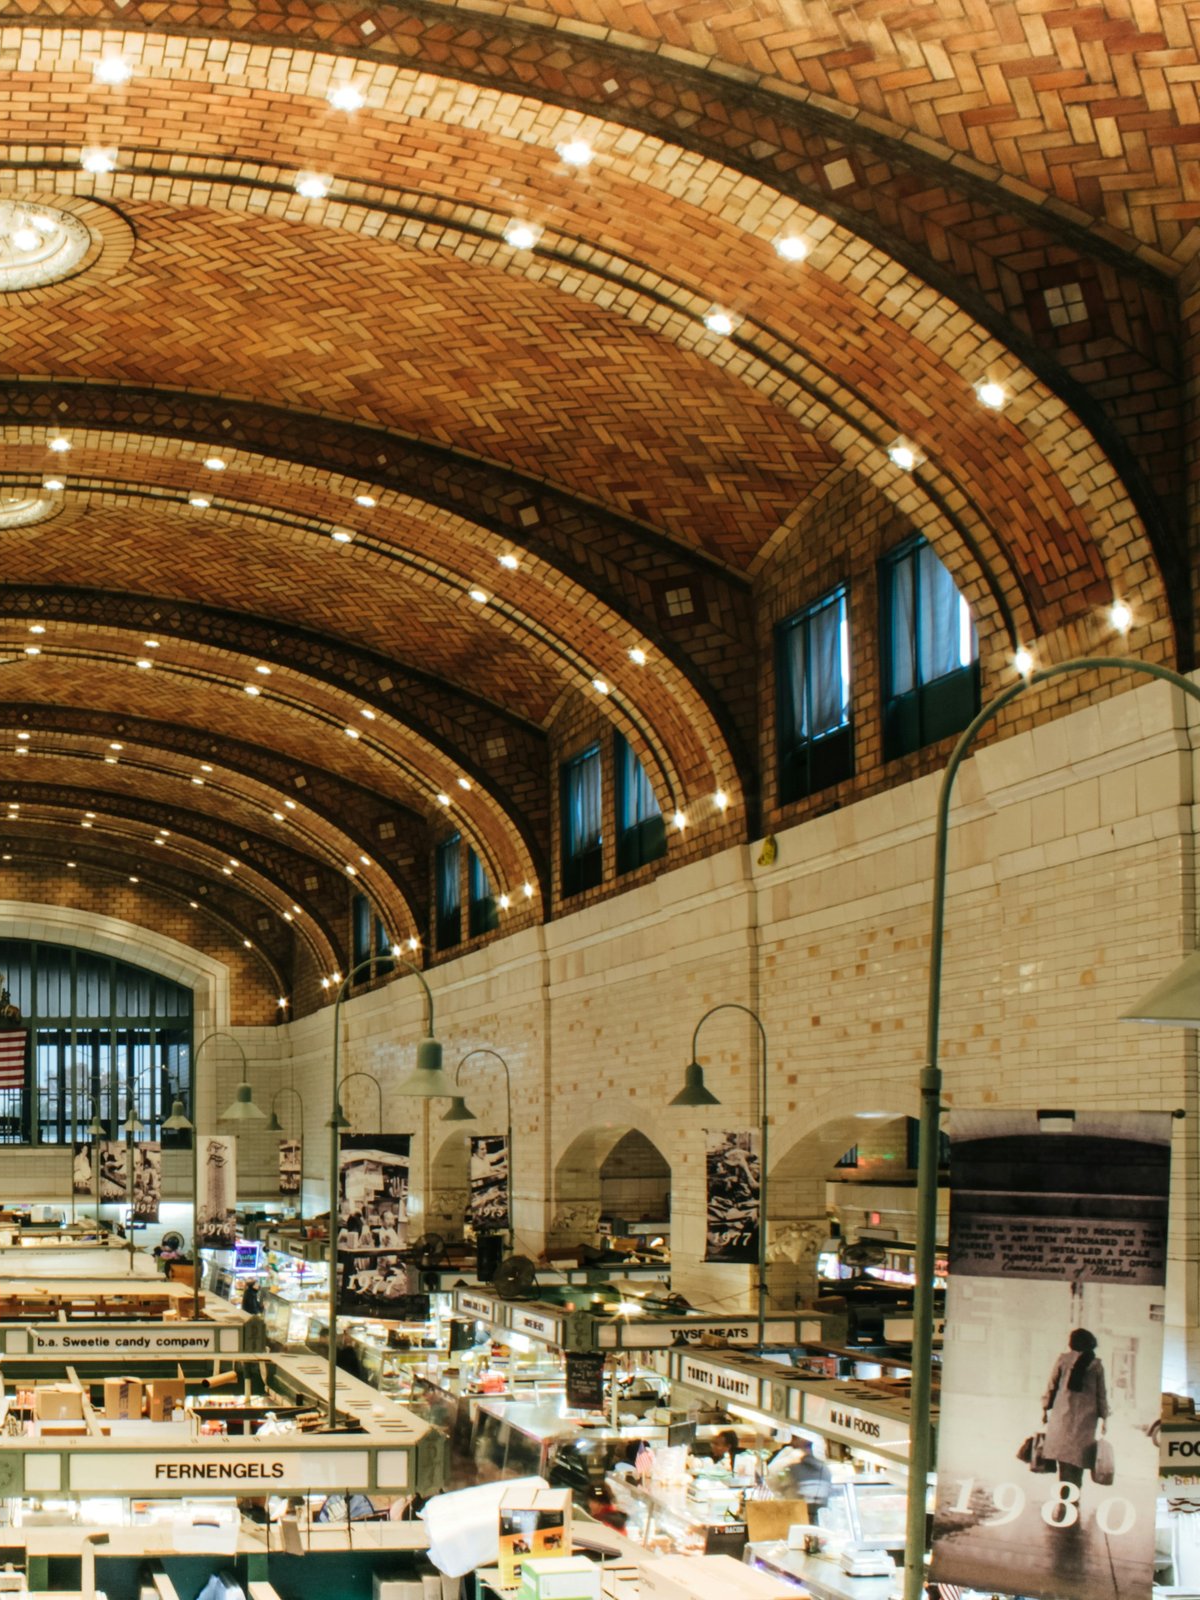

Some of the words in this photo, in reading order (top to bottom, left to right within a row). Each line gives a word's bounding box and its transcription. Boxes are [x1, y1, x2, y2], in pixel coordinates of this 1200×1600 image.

[202, 1223, 230, 1236] 1976
[1076, 1227, 1088, 1235] TO
[712, 1232, 752, 1246] 1977
[1064, 1237, 1119, 1246] PURCHASED
[1019, 1245, 1044, 1253] HAVE
[1050, 1246, 1102, 1255] INSTALLED
[1118, 1249, 1150, 1257] SCALE
[974, 1252, 995, 1260] THAT
[1002, 1253, 1044, 1263] PURPOSE
[1083, 1257, 1124, 1266] MARKET
[36, 1337, 58, 1347] b.a.
[62, 1337, 110, 1347] Sweetie
[115, 1337, 151, 1348] candy
[156, 1338, 210, 1348] company
[717, 1375, 749, 1396] BALONEY
[831, 1409, 837, 1424] M
[845, 1414, 851, 1429] M
[853, 1417, 880, 1438] FOODS
[155, 1463, 285, 1479] FERNENGELS
[948, 1477, 1136, 1536] 1980
